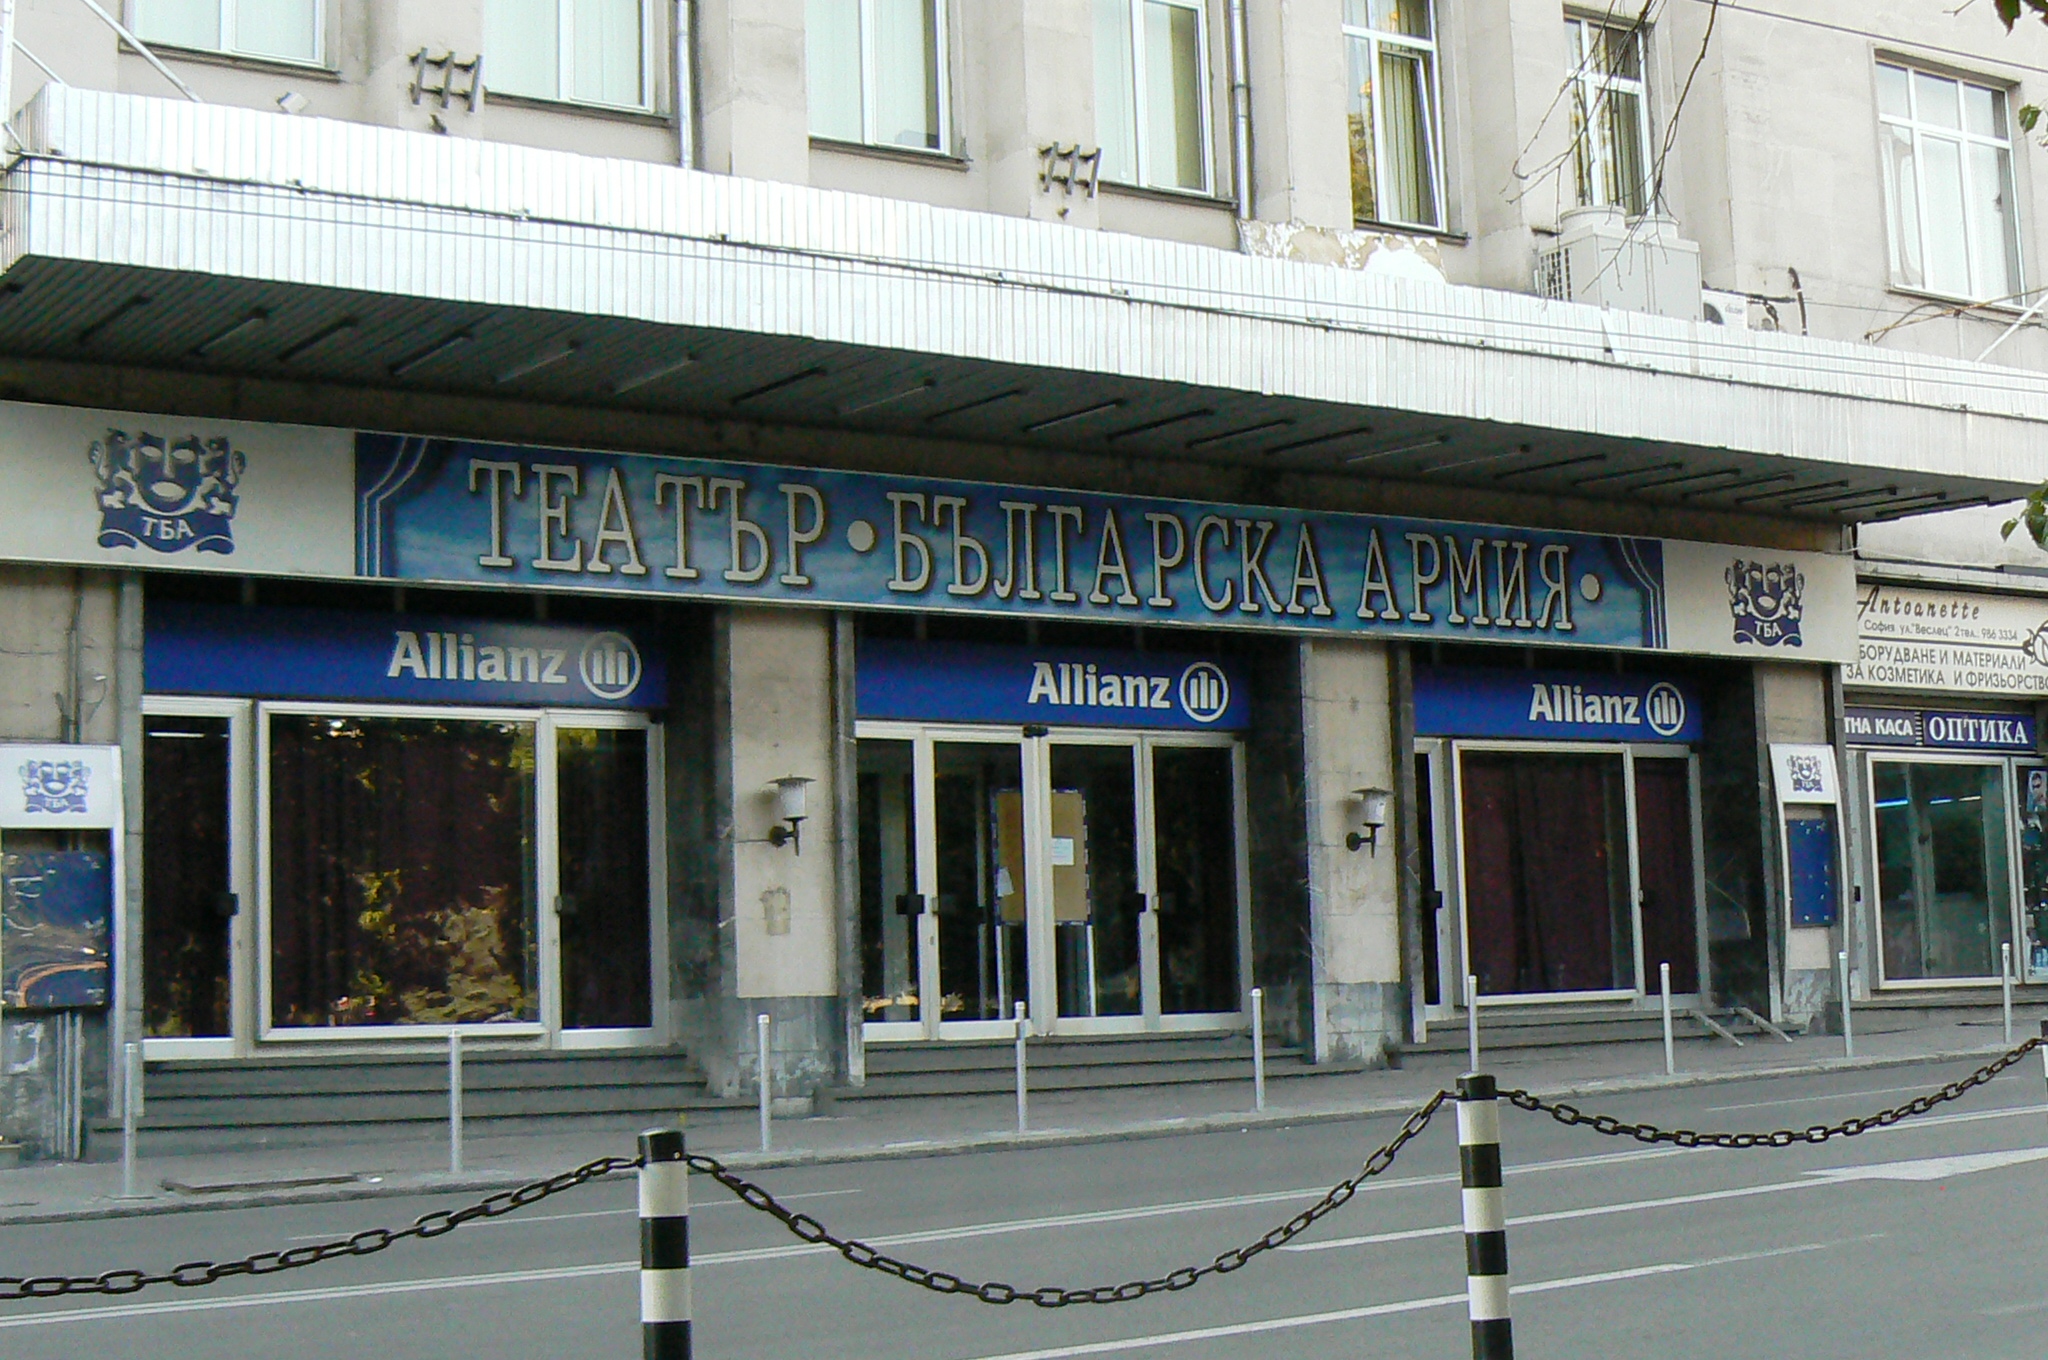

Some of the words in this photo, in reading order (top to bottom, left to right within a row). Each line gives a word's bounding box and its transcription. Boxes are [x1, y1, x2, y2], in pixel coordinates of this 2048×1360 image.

[142, 516, 194, 540] ТБА
[469, 458, 825, 585] ТЕАТЪР
[886, 491, 1332, 616] БЪЛГАРСКА
[1356, 528, 1573, 630] АРМИЯ
[1857, 584, 1980, 621] Antoanette
[1754, 620, 1782, 638] ТБА
[1863, 619, 1895, 634] София
[387, 630, 567, 684] Allianz
[1859, 644, 1936, 665] БОРУДВАНЕ
[1939, 649, 1948, 665] И
[1953, 650, 2026, 671] МАТЕРИАЛИ
[1028, 661, 1171, 709] Allianz
[1846, 663, 1864, 679] ЗА
[1868, 665, 1945, 685] КОЗМЕТИКА
[1954, 670, 1963, 686] И
[1529, 683, 1641, 725] Allianz
[1844, 716, 1872, 735] ТНА
[1875, 718, 1913, 736] КАСА
[1929, 716, 2029, 745] ОПТИКА
